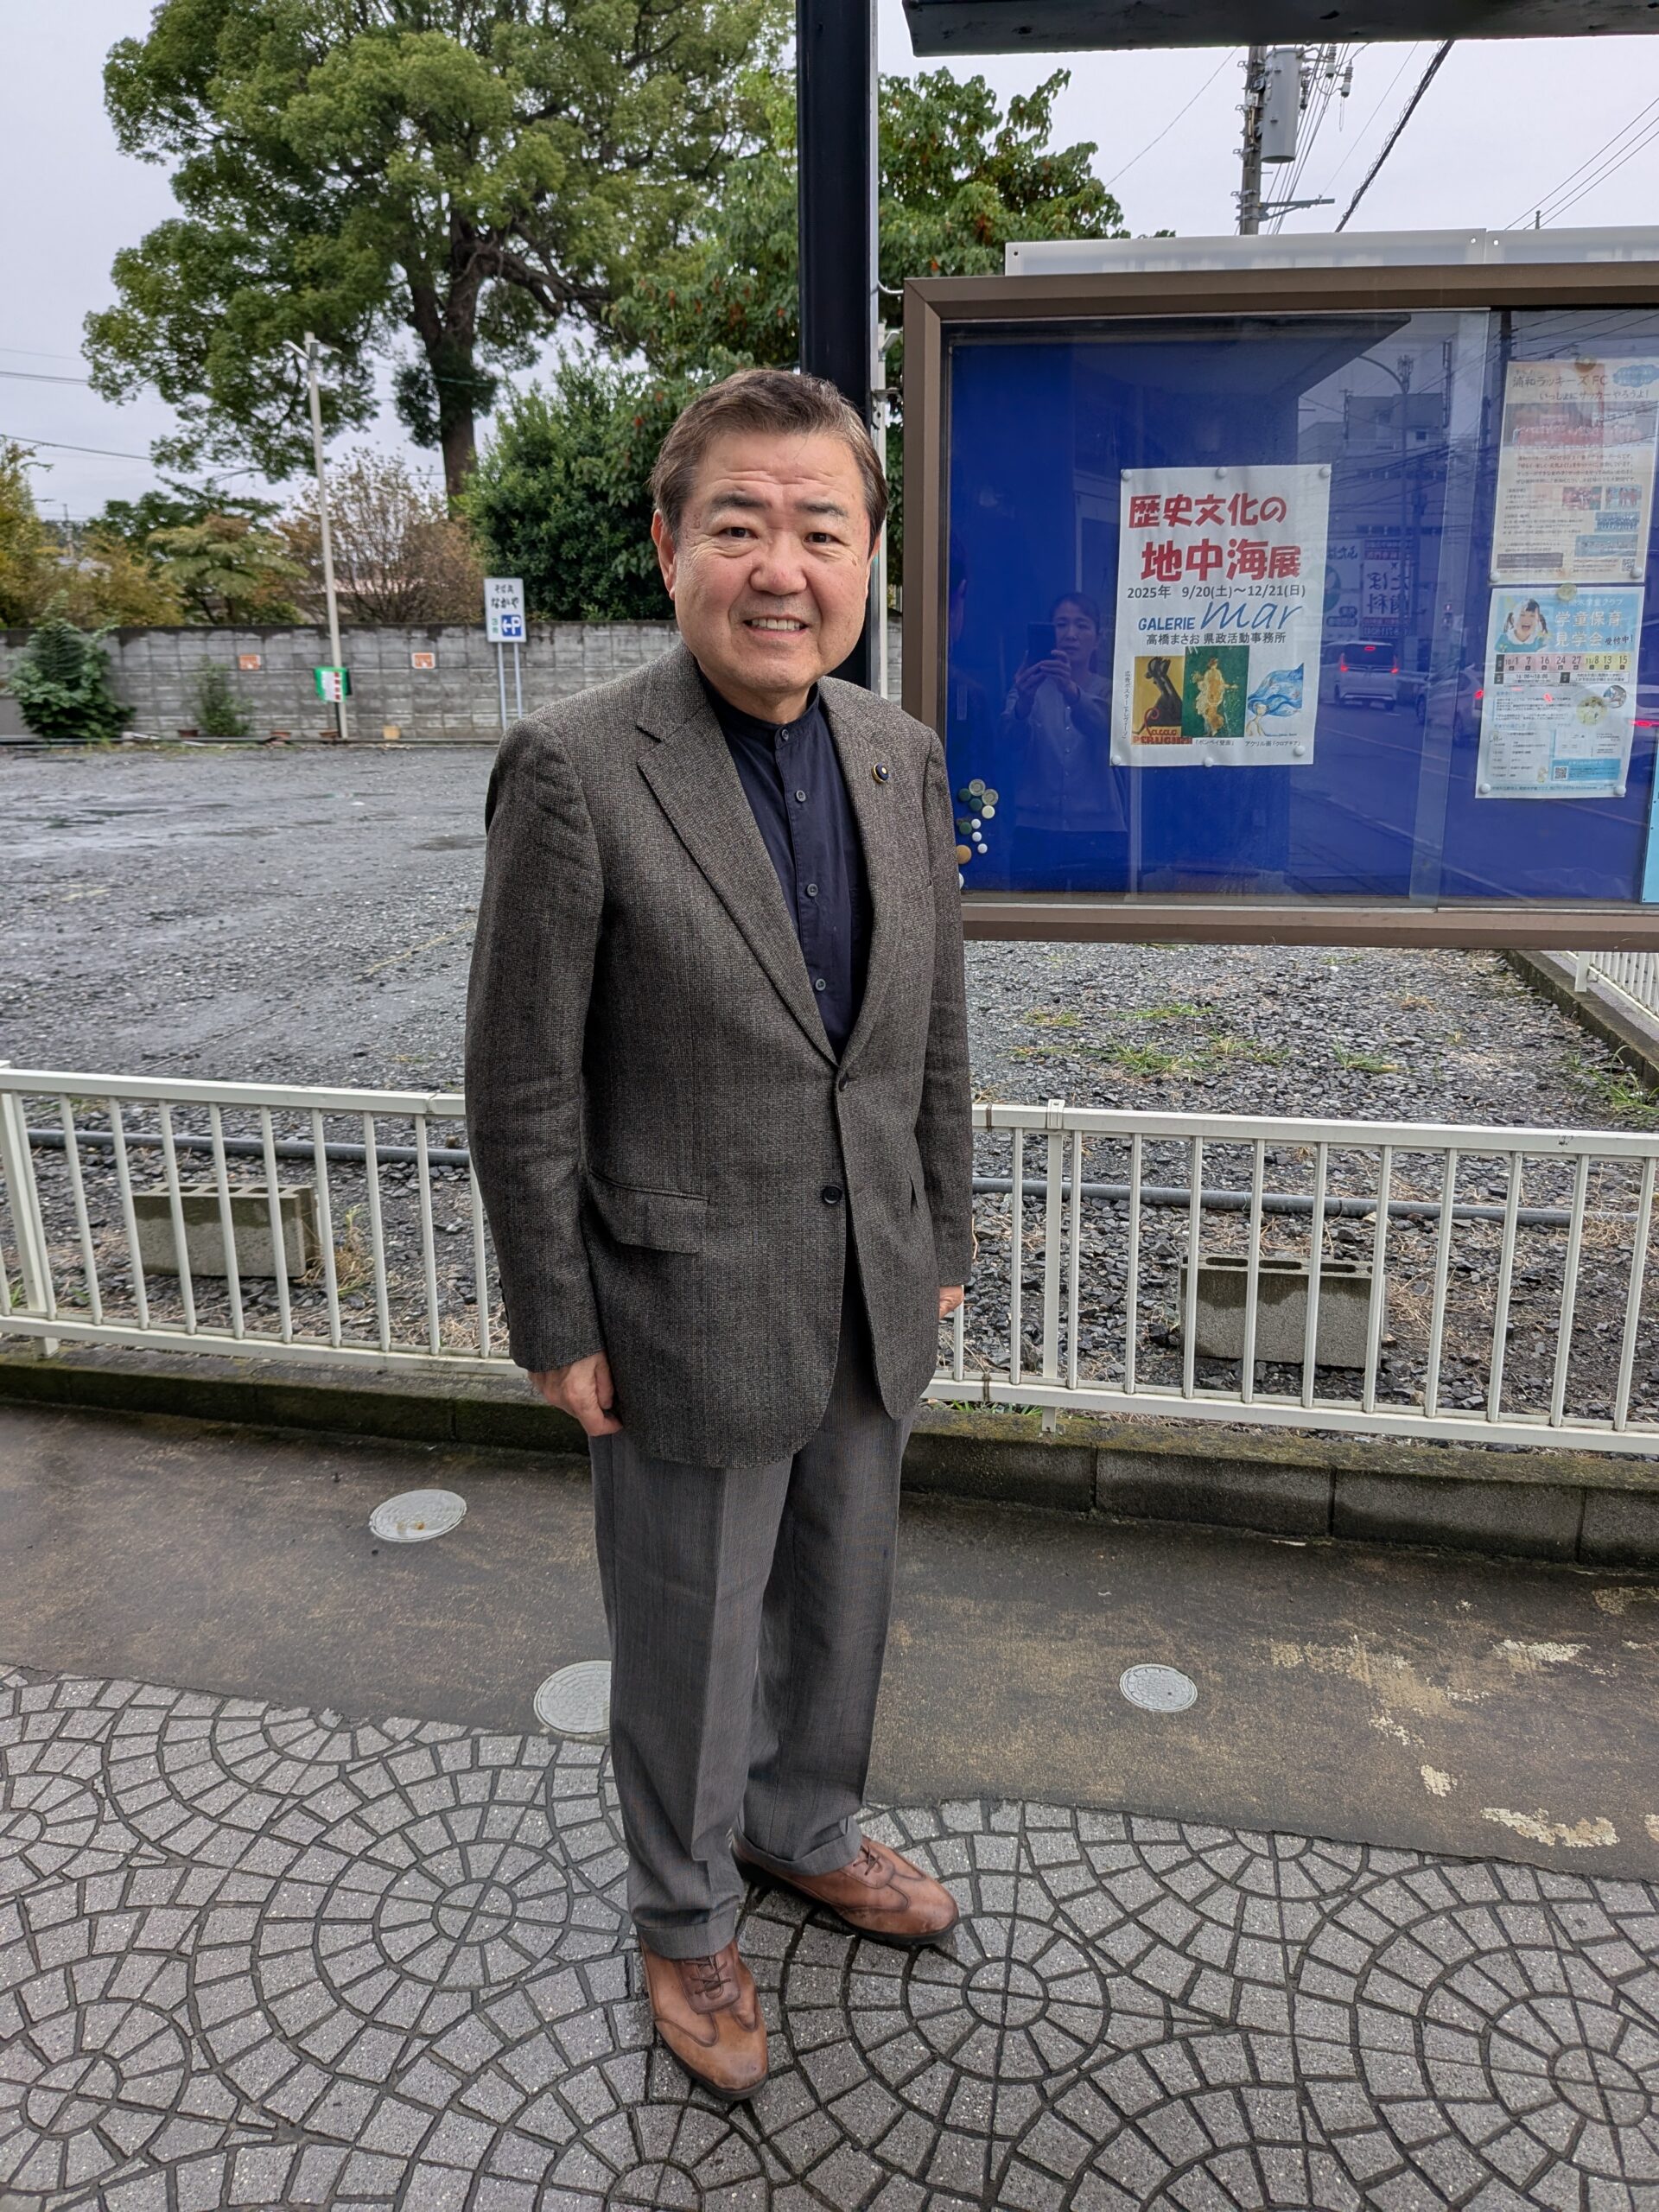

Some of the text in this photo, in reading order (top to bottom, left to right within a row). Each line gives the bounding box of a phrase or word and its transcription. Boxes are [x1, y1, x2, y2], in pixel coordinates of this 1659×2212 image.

[1592, 375, 1609, 386] FC
[1128, 492, 1287, 529] 歴史文化の
[1141, 538, 1301, 582] 地中海展
[1127, 585, 1172, 599] 2025年
[1138, 617, 1196, 631] GALERIE
[1200, 601, 1303, 630] mar
[1555, 611, 1623, 627] 学童保育
[1146, 632, 1287, 645] 高橋まさお 県政活動事務所
[1555, 632, 1604, 647] 見学会
[1541, 656, 1550, 664] 16
[1556, 656, 1566, 664] 24
[1573, 656, 1581, 664] 27
[1603, 656, 1612, 664] 13
[1619, 655, 1628, 664] 15
